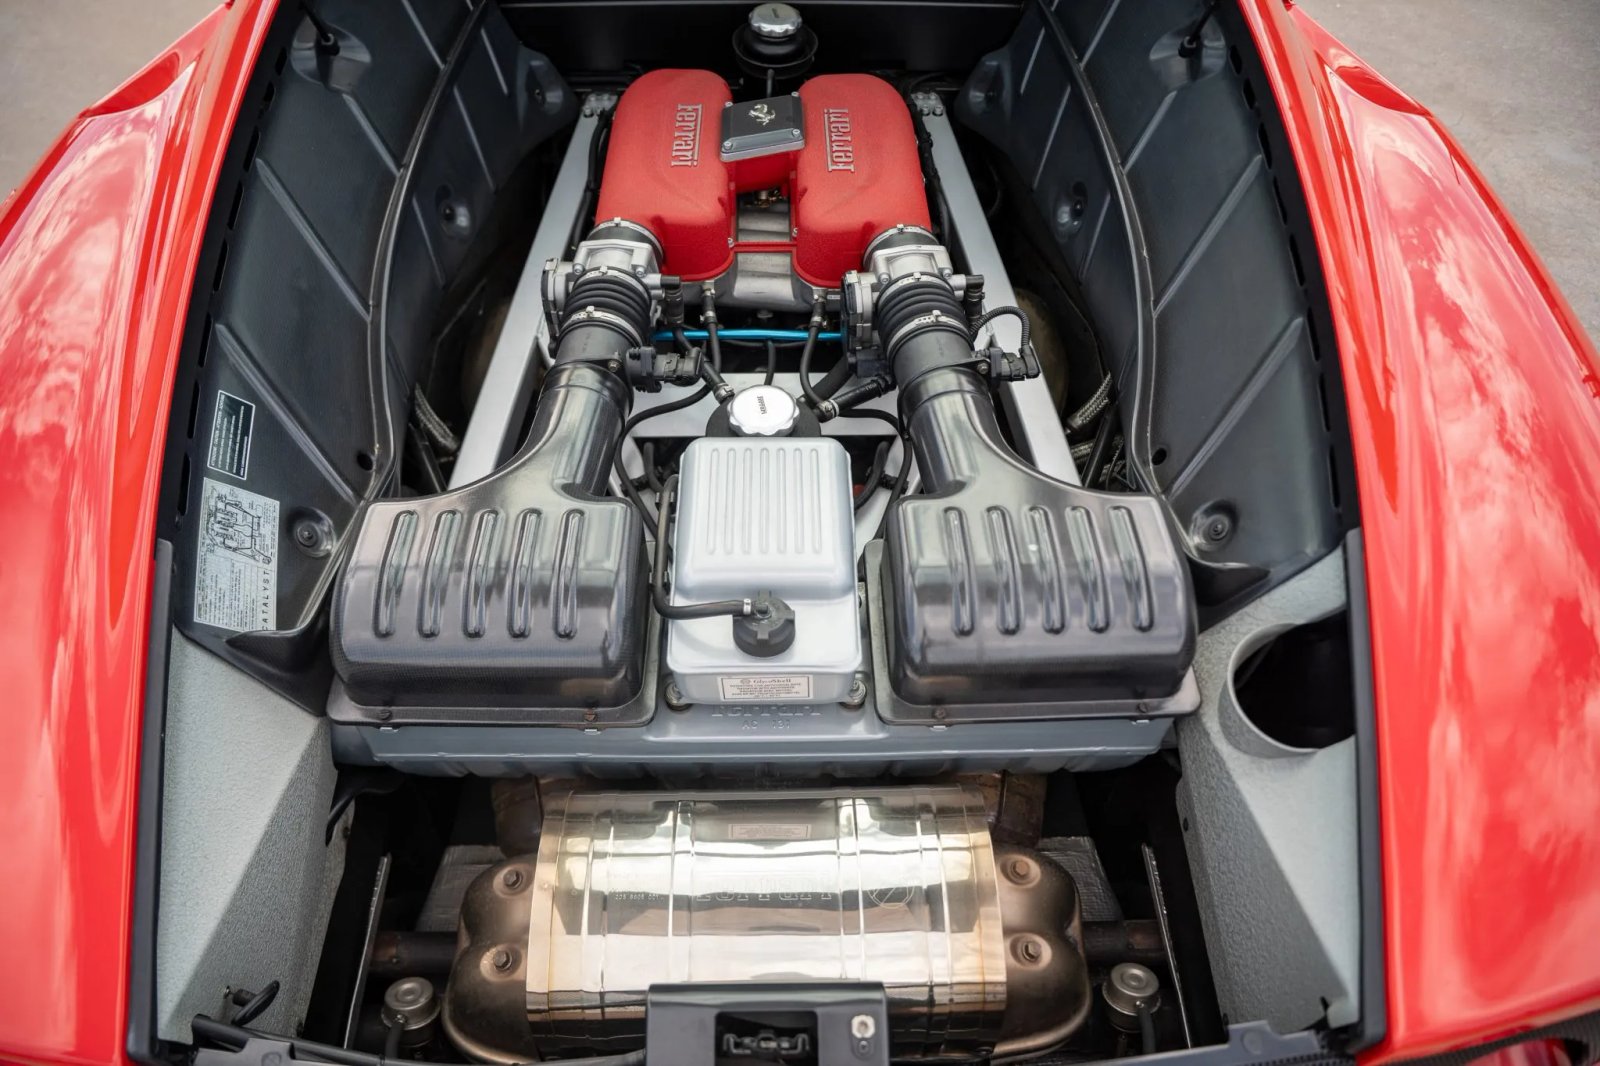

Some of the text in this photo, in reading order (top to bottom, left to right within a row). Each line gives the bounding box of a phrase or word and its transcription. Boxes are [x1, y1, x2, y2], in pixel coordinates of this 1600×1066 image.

[671, 103, 702, 167] Ferrari
[824, 108, 855, 173] Ferrari
[261, 569, 270, 631] CATALYST
